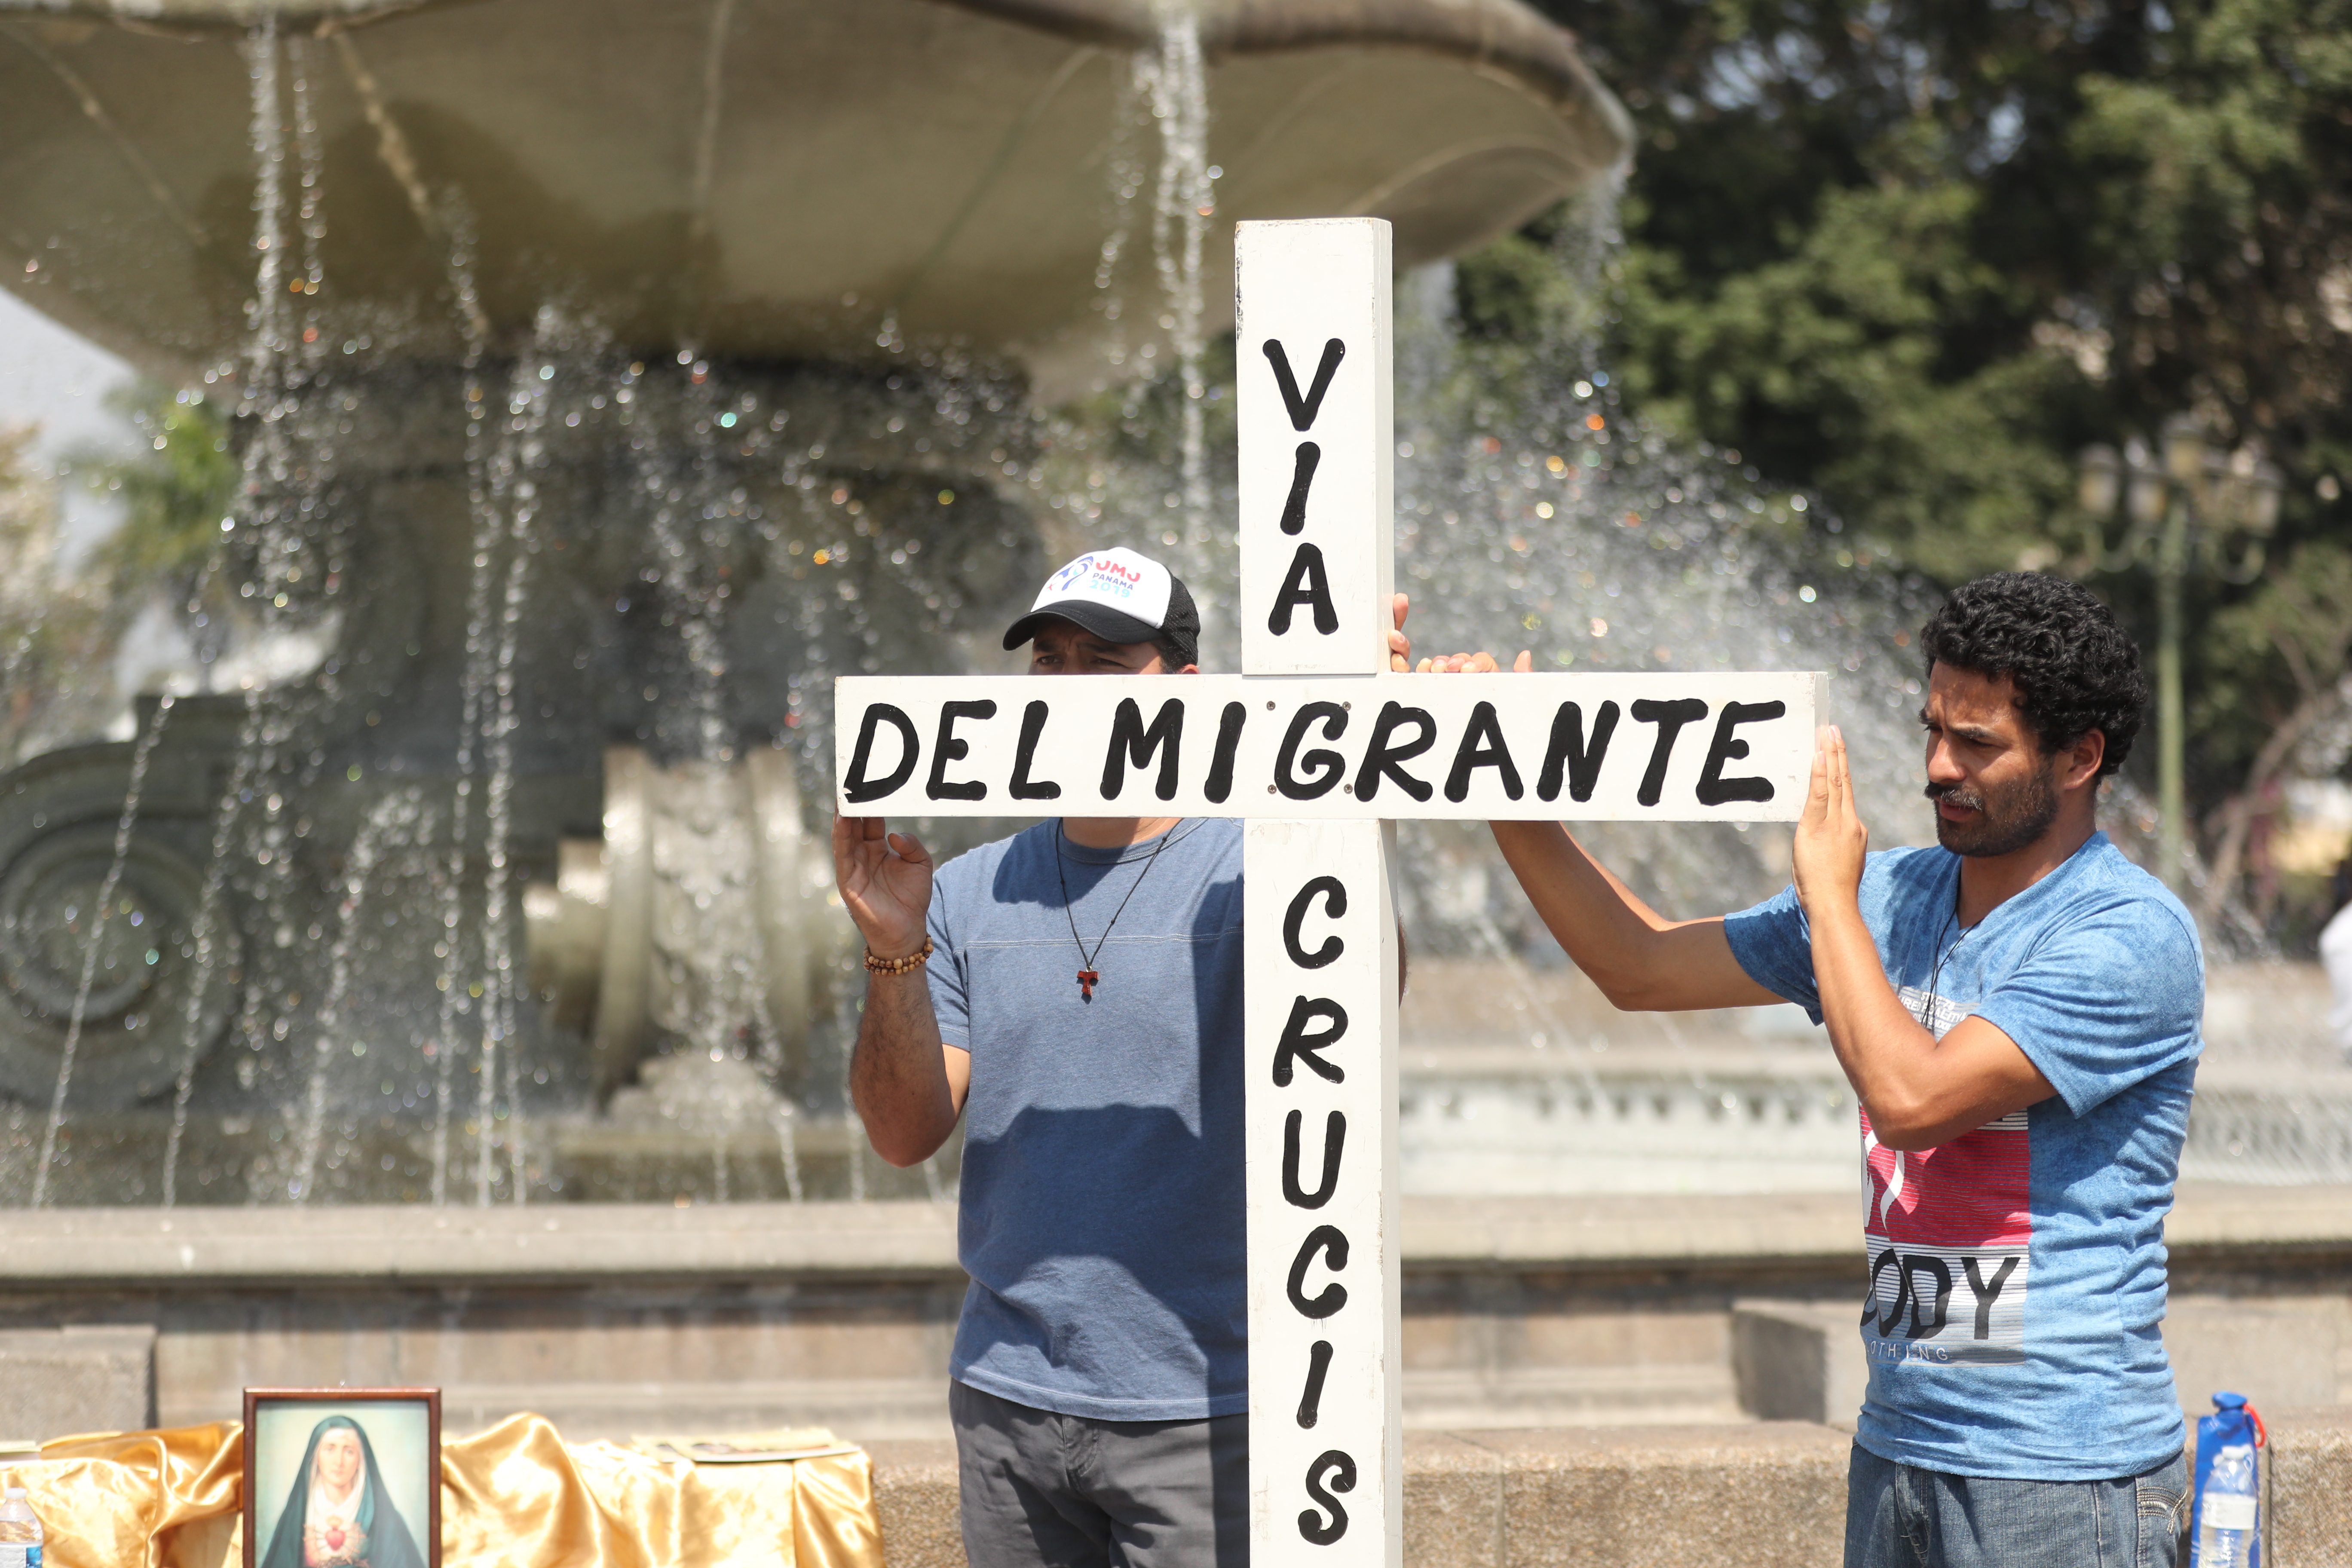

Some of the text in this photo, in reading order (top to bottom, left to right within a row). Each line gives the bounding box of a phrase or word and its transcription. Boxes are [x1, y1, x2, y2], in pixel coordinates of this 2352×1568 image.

[1262, 337, 1346, 637] VIA
[1089, 579, 1130, 598] 2019
[1095, 560, 1141, 582] JMJ
[843, 697, 1786, 807] DEL MIGRANTE
[1272, 875, 1357, 1546] CRUCIS
[1865, 1338, 1948, 1361] OTHING
